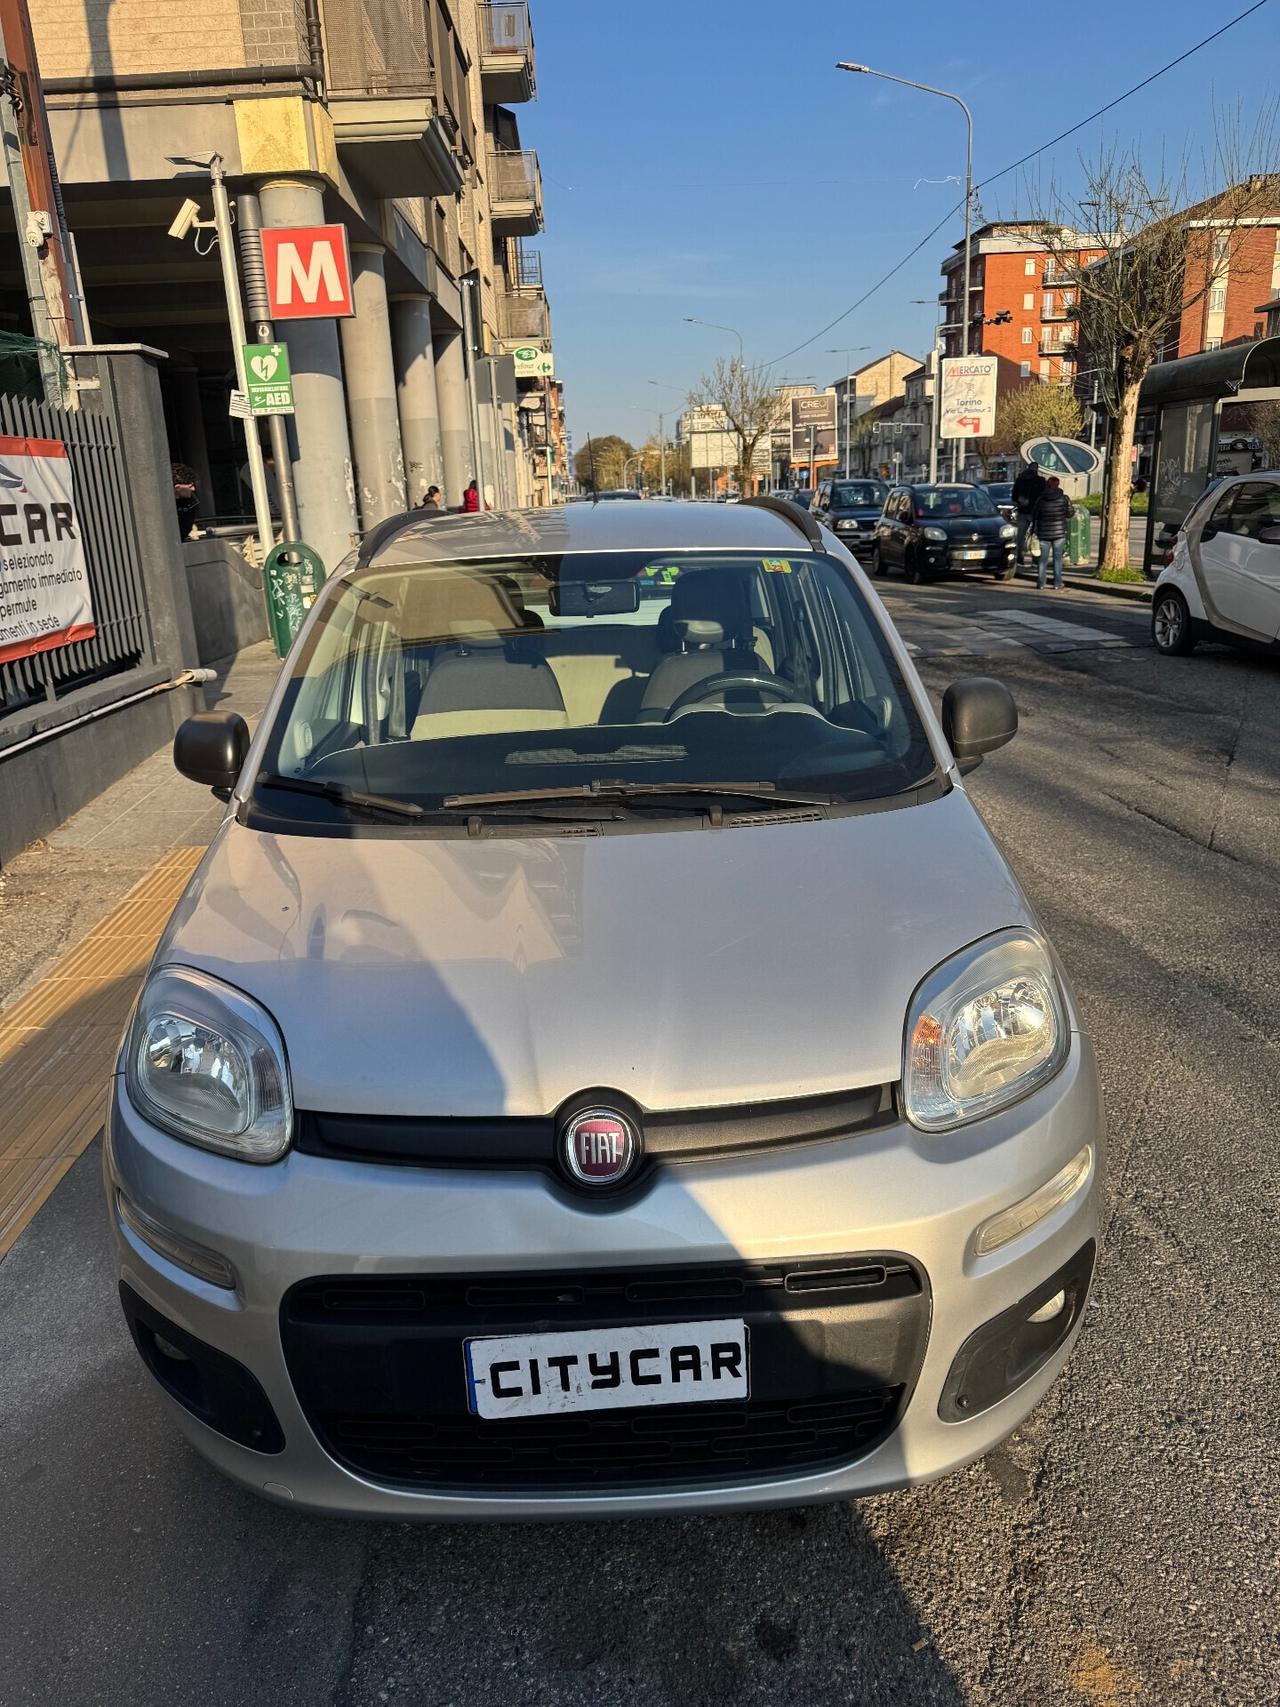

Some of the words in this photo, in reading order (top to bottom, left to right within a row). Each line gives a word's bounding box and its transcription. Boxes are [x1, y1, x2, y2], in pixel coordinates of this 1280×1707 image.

[276, 240, 345, 305] M
[948, 365, 991, 376] MERCATO
[266, 392, 291, 406] AED
[801, 400, 826, 408] CREO
[956, 398, 983, 406] Torino
[0, 503, 76, 546] CAR
[3, 551, 54, 571] selezionato
[38, 567, 82, 587] immediato
[0, 597, 37, 621] permute
[26, 619, 38, 634] in
[38, 614, 60, 631] sede
[581, 1132, 620, 1164] FIAT
[489, 1341, 742, 1399] CITYCAR
